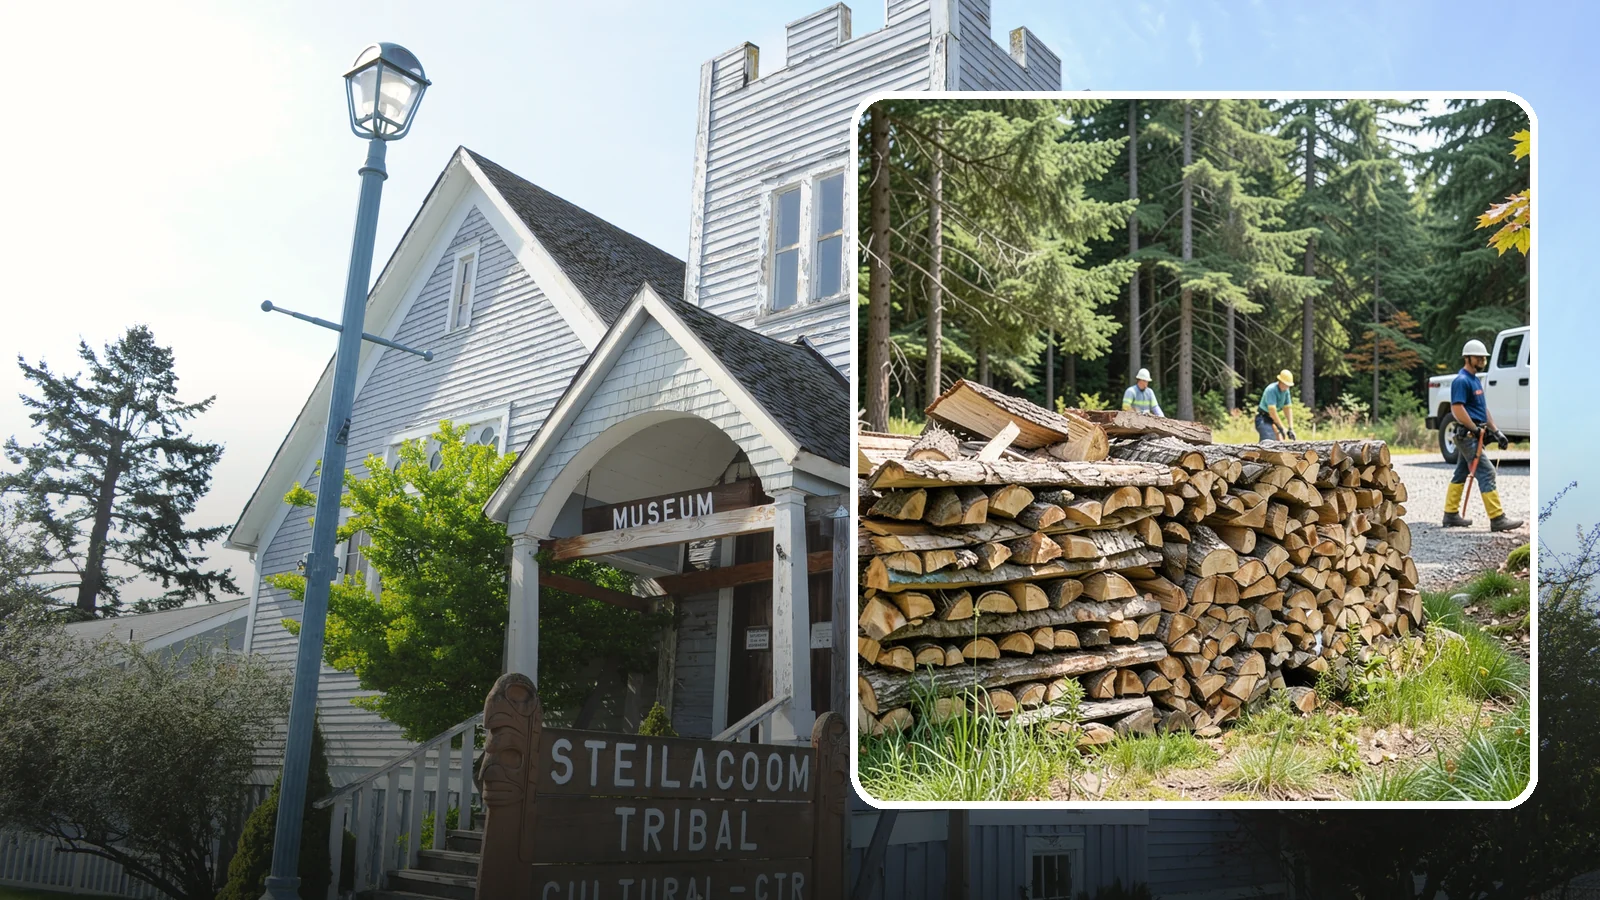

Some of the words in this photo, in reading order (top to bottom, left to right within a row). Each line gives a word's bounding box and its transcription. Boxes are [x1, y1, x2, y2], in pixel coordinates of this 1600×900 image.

[613, 491, 714, 531] MUSEUM
[551, 738, 809, 792] STEILACOOM
[615, 806, 757, 852] TRIBAL
